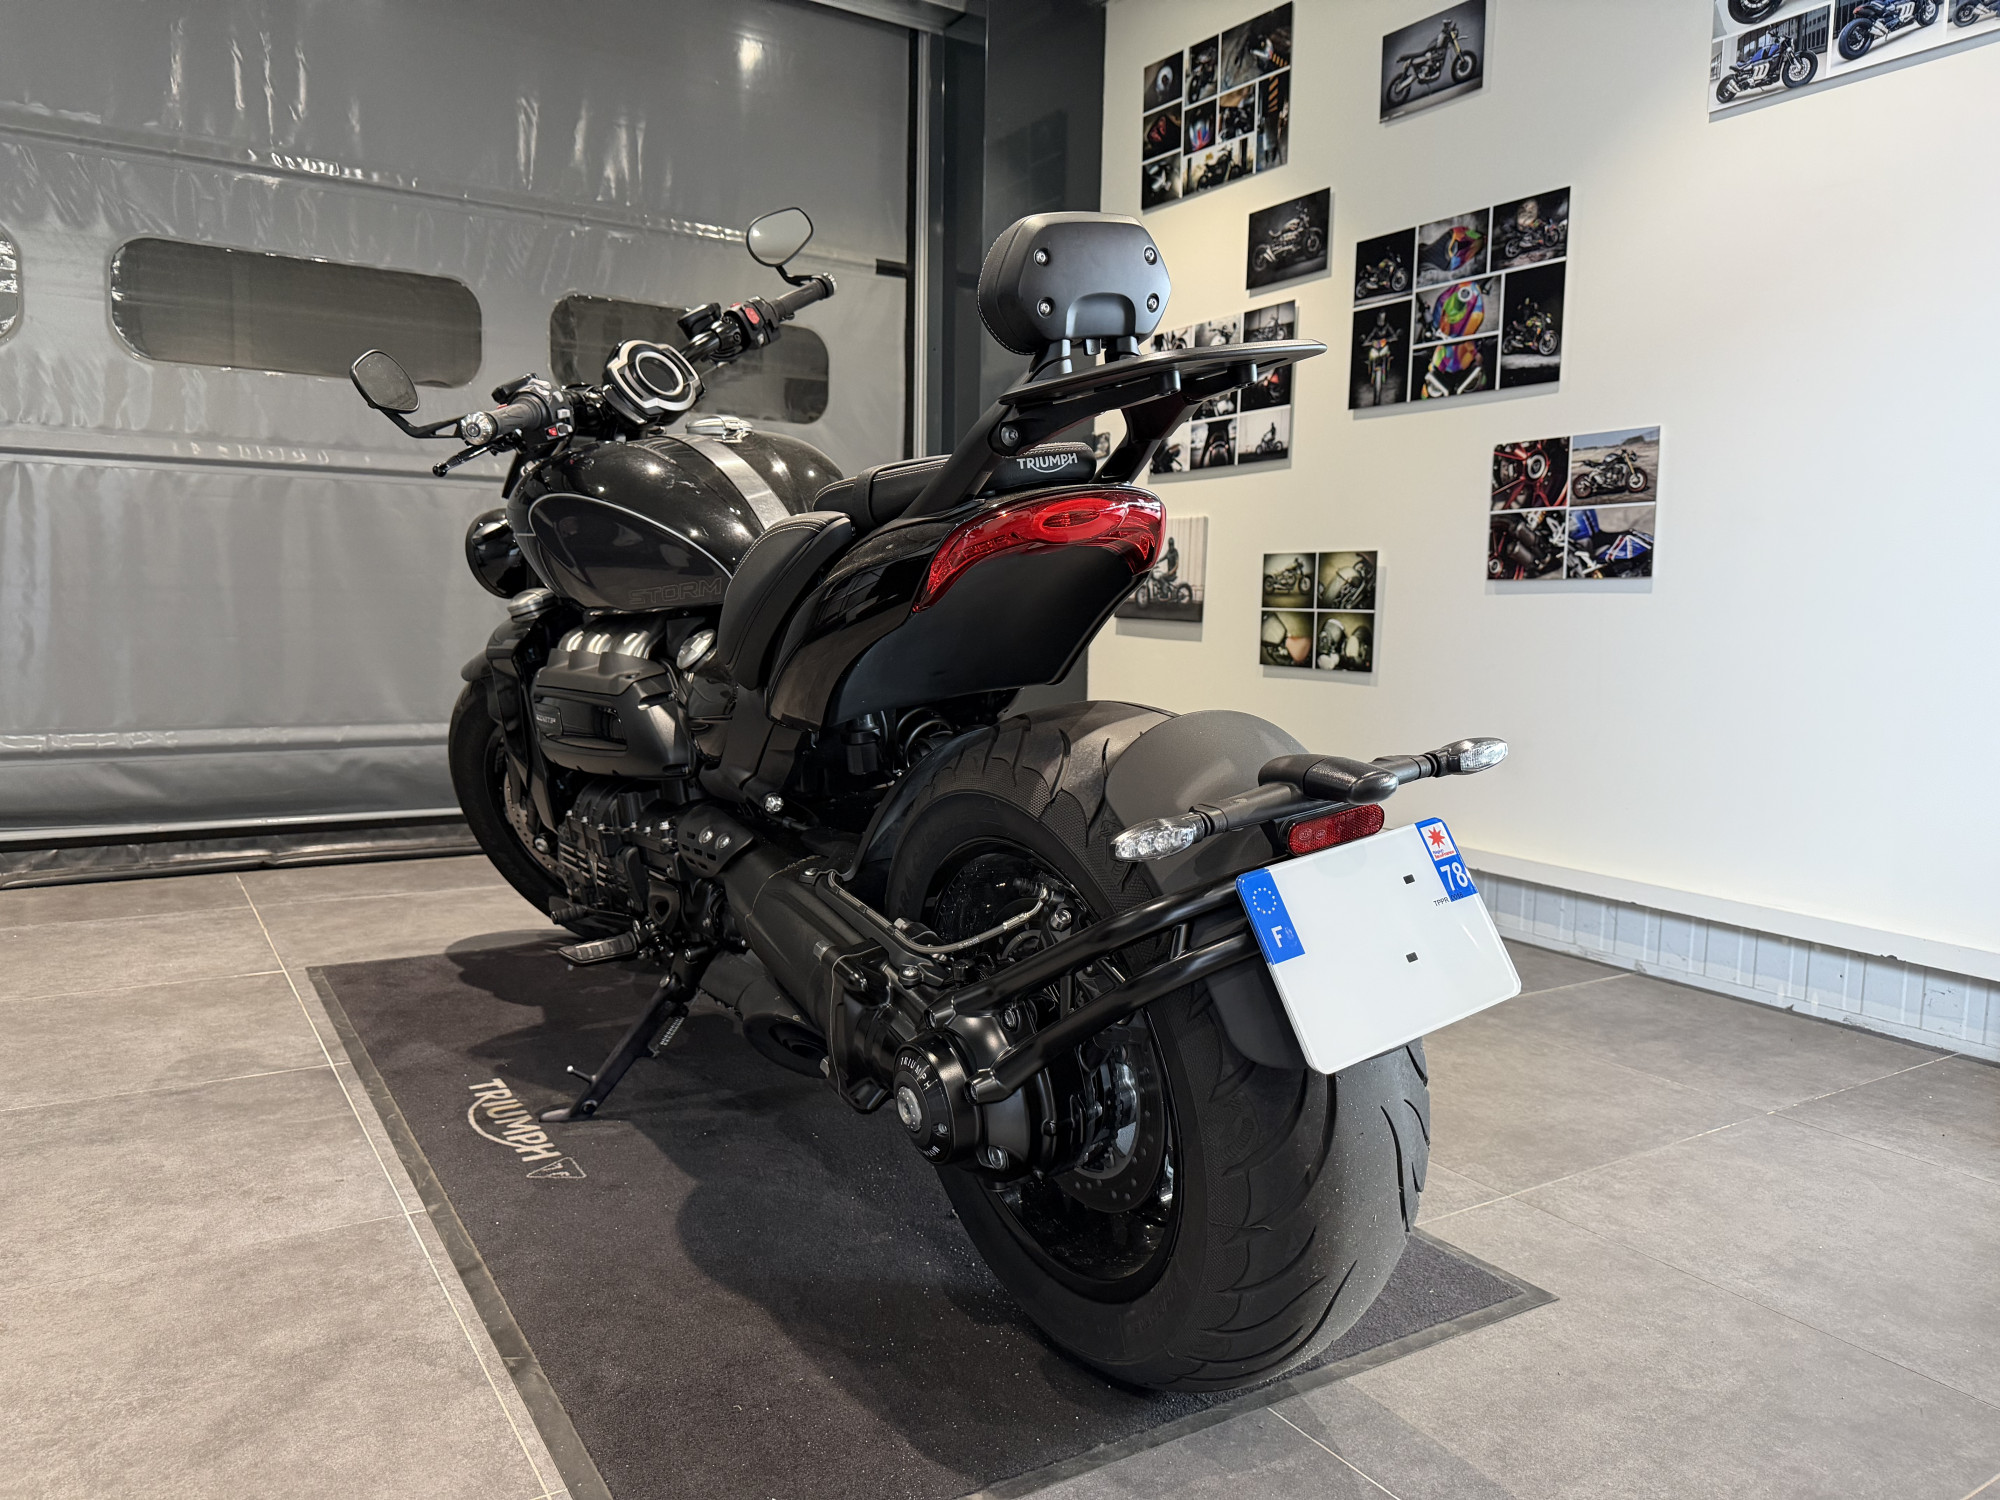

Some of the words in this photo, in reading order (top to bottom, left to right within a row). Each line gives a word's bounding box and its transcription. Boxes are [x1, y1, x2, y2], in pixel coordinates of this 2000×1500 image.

[1017, 453, 1078, 473] TRIUMPH
[630, 577, 722, 605] STORM
[1440, 862, 1468, 891] 78
[1271, 925, 1283, 948] F
[901, 1056, 931, 1090] TRIUMPH
[468, 1077, 562, 1162] TRIUMPH
